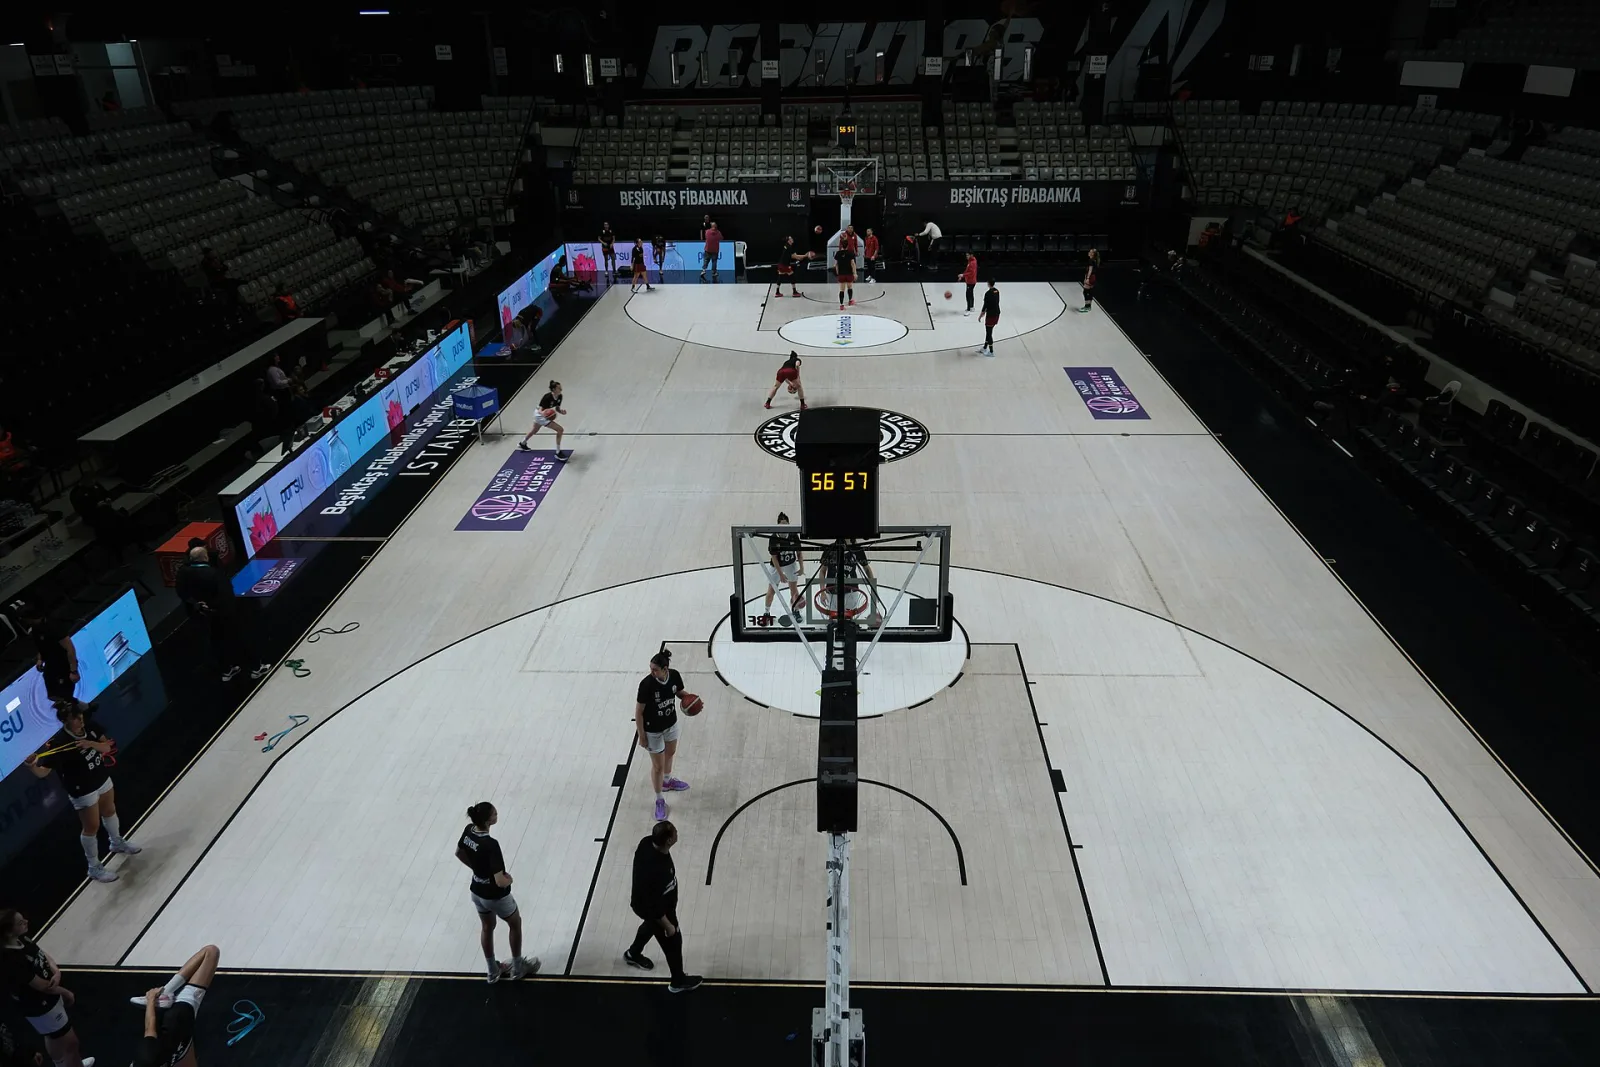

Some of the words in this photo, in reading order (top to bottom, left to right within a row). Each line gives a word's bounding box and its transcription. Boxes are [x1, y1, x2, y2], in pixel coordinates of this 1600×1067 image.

[620, 188, 676, 210] BEŞİKTAŞ
[680, 188, 748, 206] FİBABANKA
[950, 185, 1008, 208] BEŞİKTAŞ
[1011, 185, 1082, 204] FİBABANKA
[452, 339, 466, 360] pursu
[405, 379, 420, 402] pursu
[356, 416, 375, 444] pursu
[320, 472, 389, 515] Beşiktaş
[366, 428, 427, 470] Fibabanka
[413, 410, 445, 427] Spor
[489, 478, 508, 492] ING
[526, 462, 555, 492] KUPASI
[811, 472, 835, 491] 56
[844, 472, 868, 491] 57
[280, 474, 304, 511] pursu
